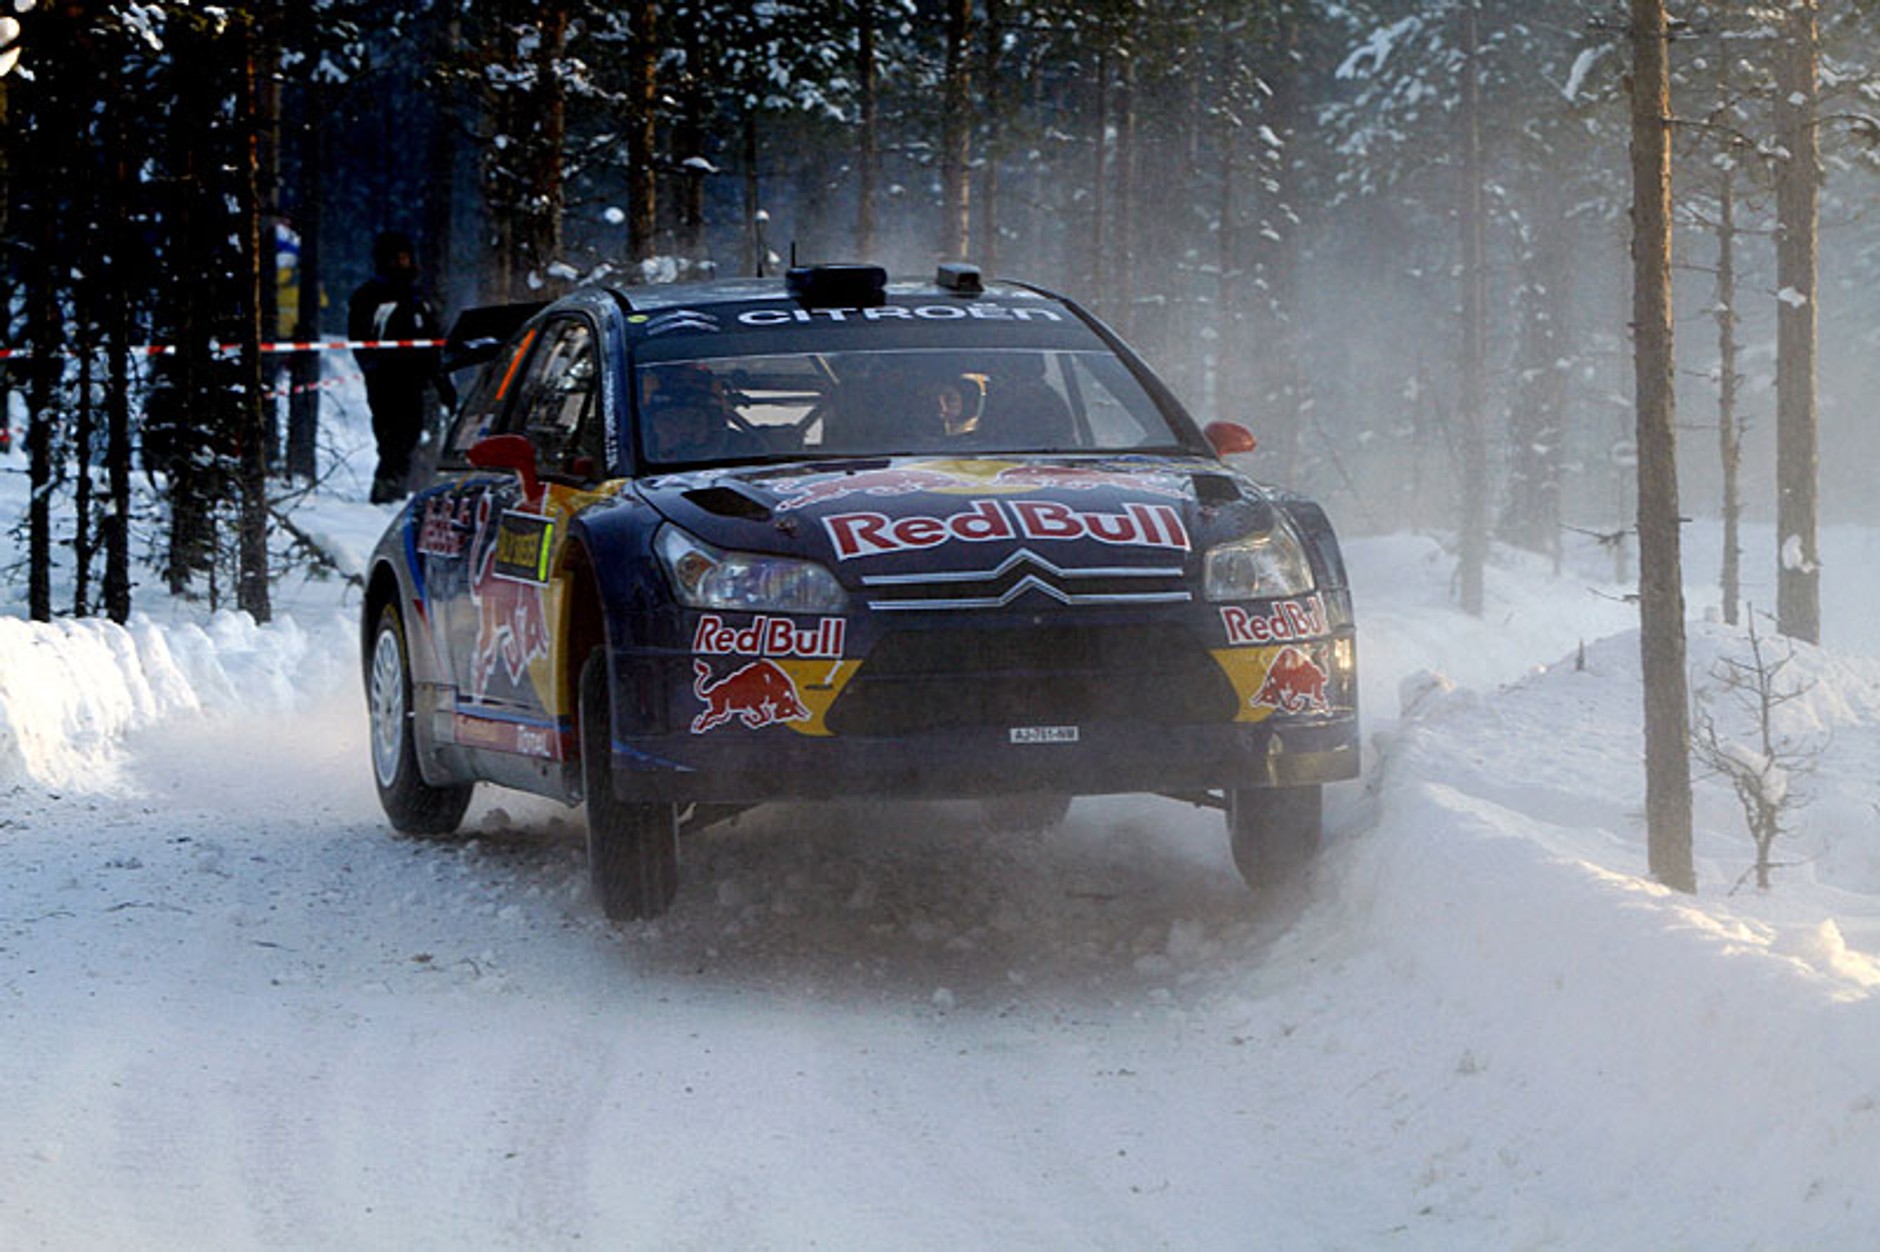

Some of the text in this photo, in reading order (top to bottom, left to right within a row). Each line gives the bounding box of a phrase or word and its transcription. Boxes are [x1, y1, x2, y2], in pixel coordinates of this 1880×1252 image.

[821, 499, 1191, 561] Red Bull
[692, 615, 846, 657] Red Bull
[1219, 601, 1293, 645] Red
